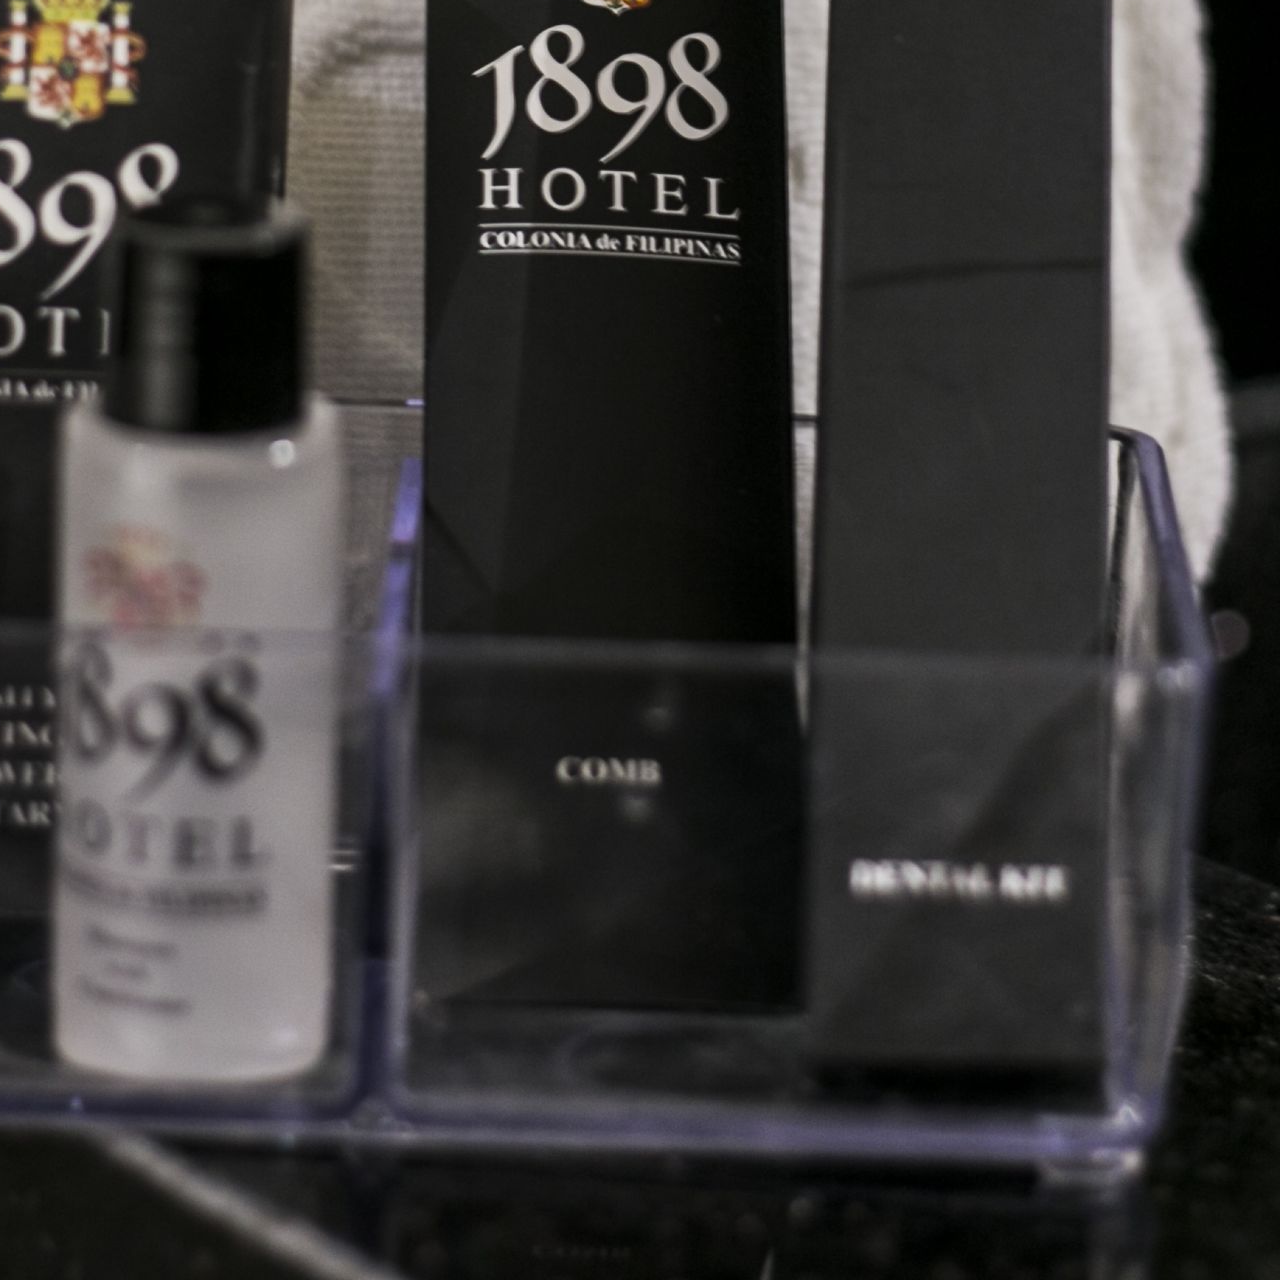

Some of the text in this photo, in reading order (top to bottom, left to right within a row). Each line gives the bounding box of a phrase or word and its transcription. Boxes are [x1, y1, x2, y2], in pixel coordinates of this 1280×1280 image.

[472, 24, 730, 163] 1898
[478, 166, 741, 221] HOTEL
[479, 230, 741, 260] COLONIA de FILIPINAS
[68, 630, 266, 803] 898
[556, 756, 662, 784] COMB
[70, 798, 273, 869] OTEL
